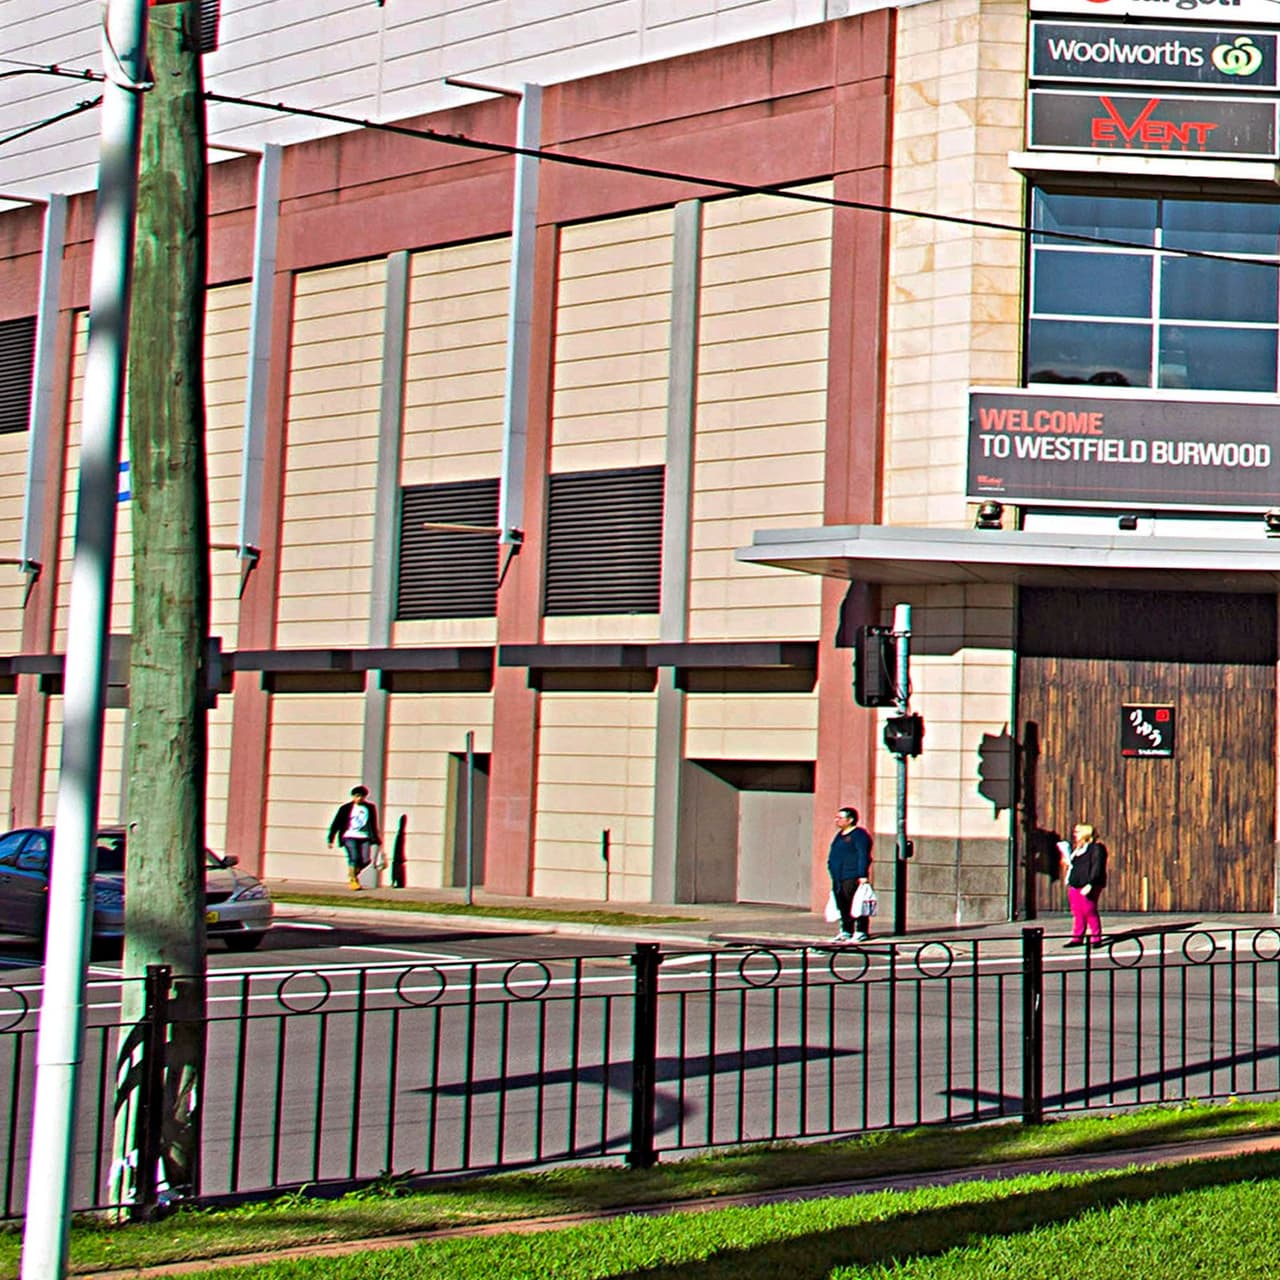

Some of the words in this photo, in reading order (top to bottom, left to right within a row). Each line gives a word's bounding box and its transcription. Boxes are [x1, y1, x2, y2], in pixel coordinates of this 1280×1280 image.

[1048, 38, 1204, 67] Woolworths
[1091, 95, 1219, 144] EVENT
[979, 408, 1104, 435] WELCOME
[979, 434, 1010, 458] TO
[1015, 436, 1147, 463] WESTFIELD
[1152, 440, 1271, 468] BURWOOD
